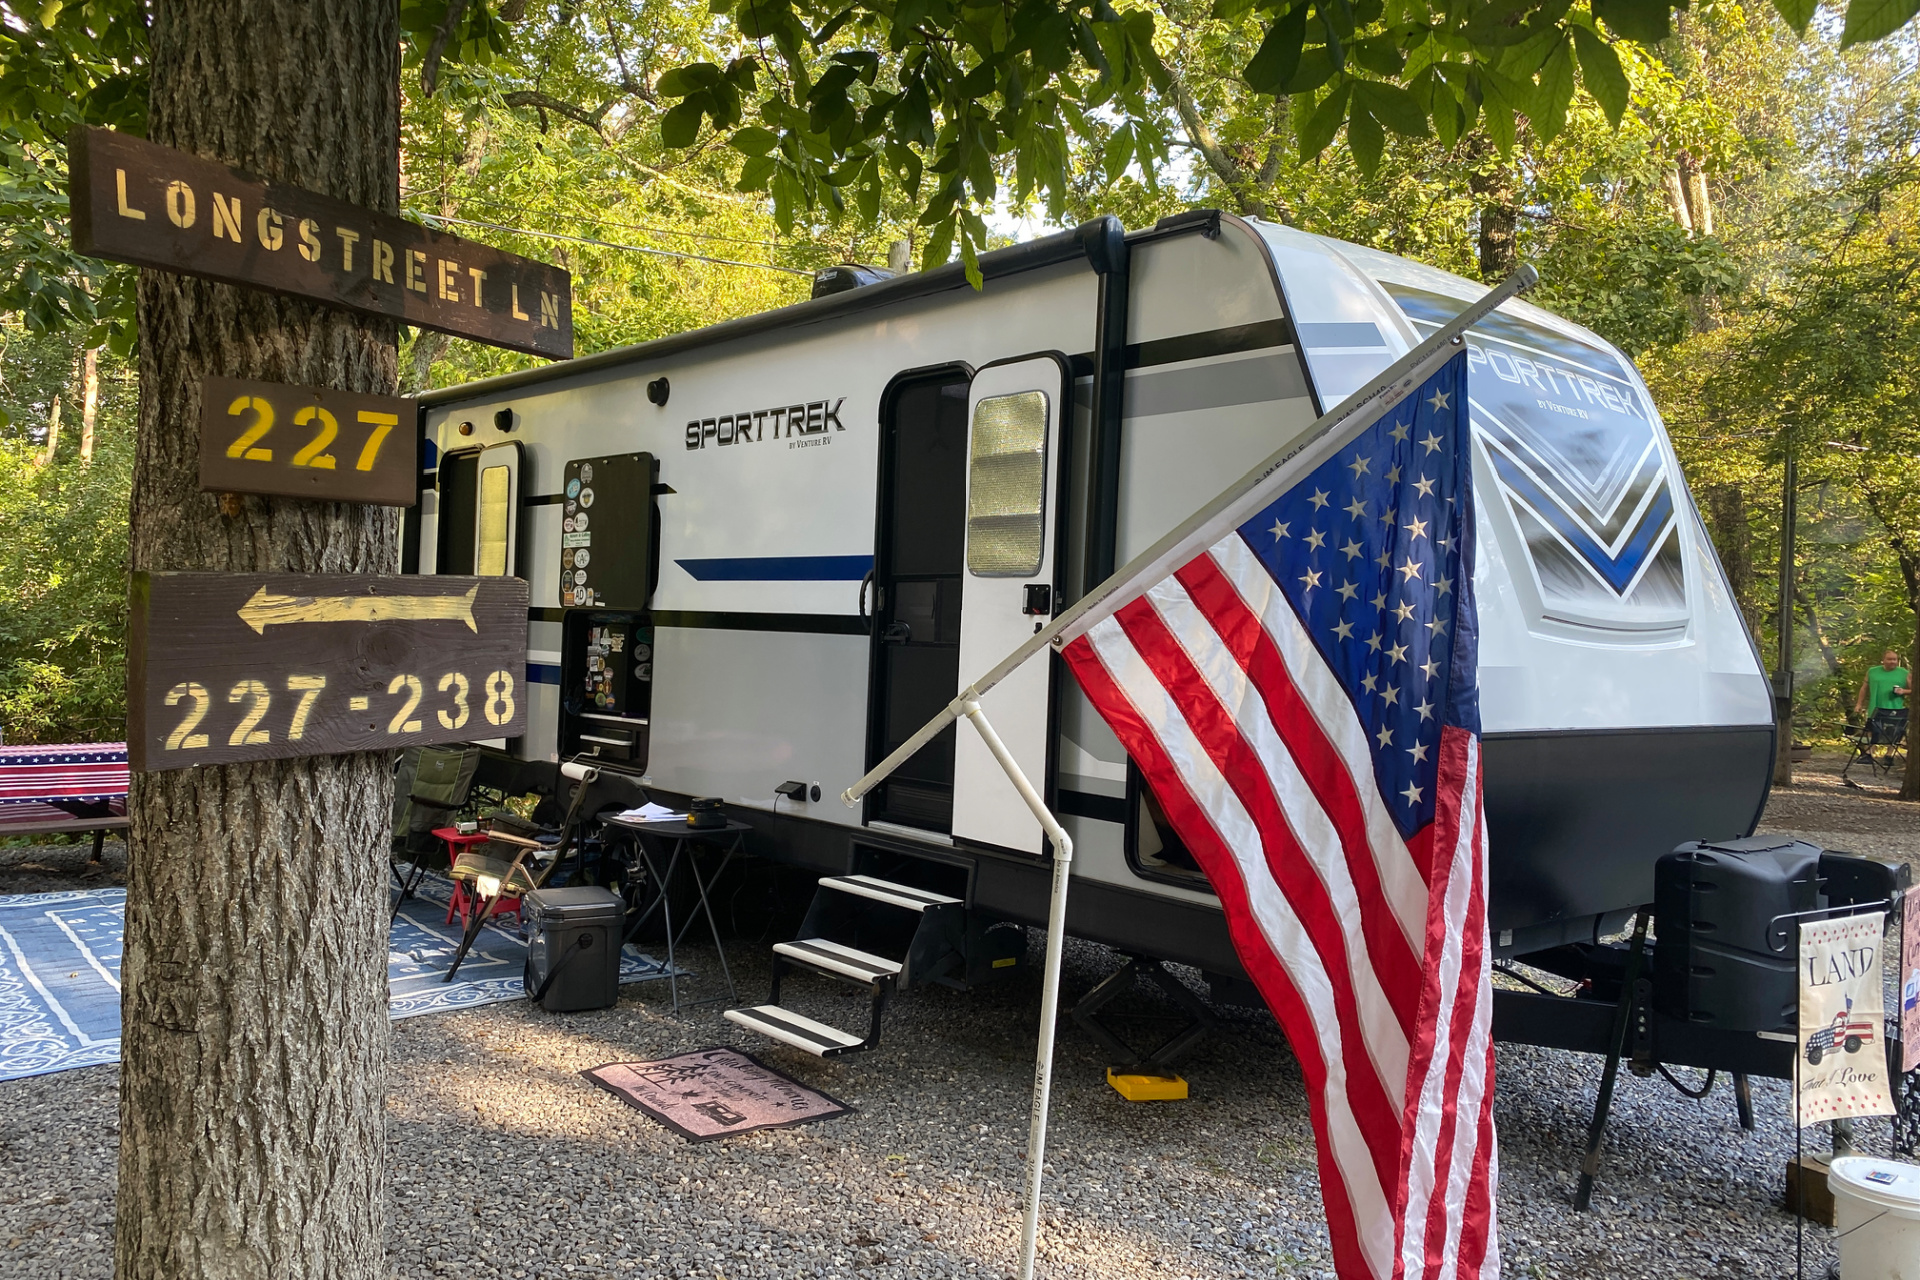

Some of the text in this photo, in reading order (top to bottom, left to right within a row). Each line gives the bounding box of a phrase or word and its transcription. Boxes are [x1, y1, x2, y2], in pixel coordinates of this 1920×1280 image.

[116, 168, 560, 330] LONGSTREET LN
[1467, 343, 1645, 420] PORTTREK
[225, 395, 399, 472] 227
[685, 396, 848, 451] SPORTTREK
[1577, 408, 1589, 420] RV
[163, 670, 515, 751] 227-238
[1808, 946, 1874, 987] LAND
[1836, 1066, 1878, 1088] Love
[1031, 1087, 1042, 1122] EAGLE
[1023, 1178, 1033, 1212] SCH40
